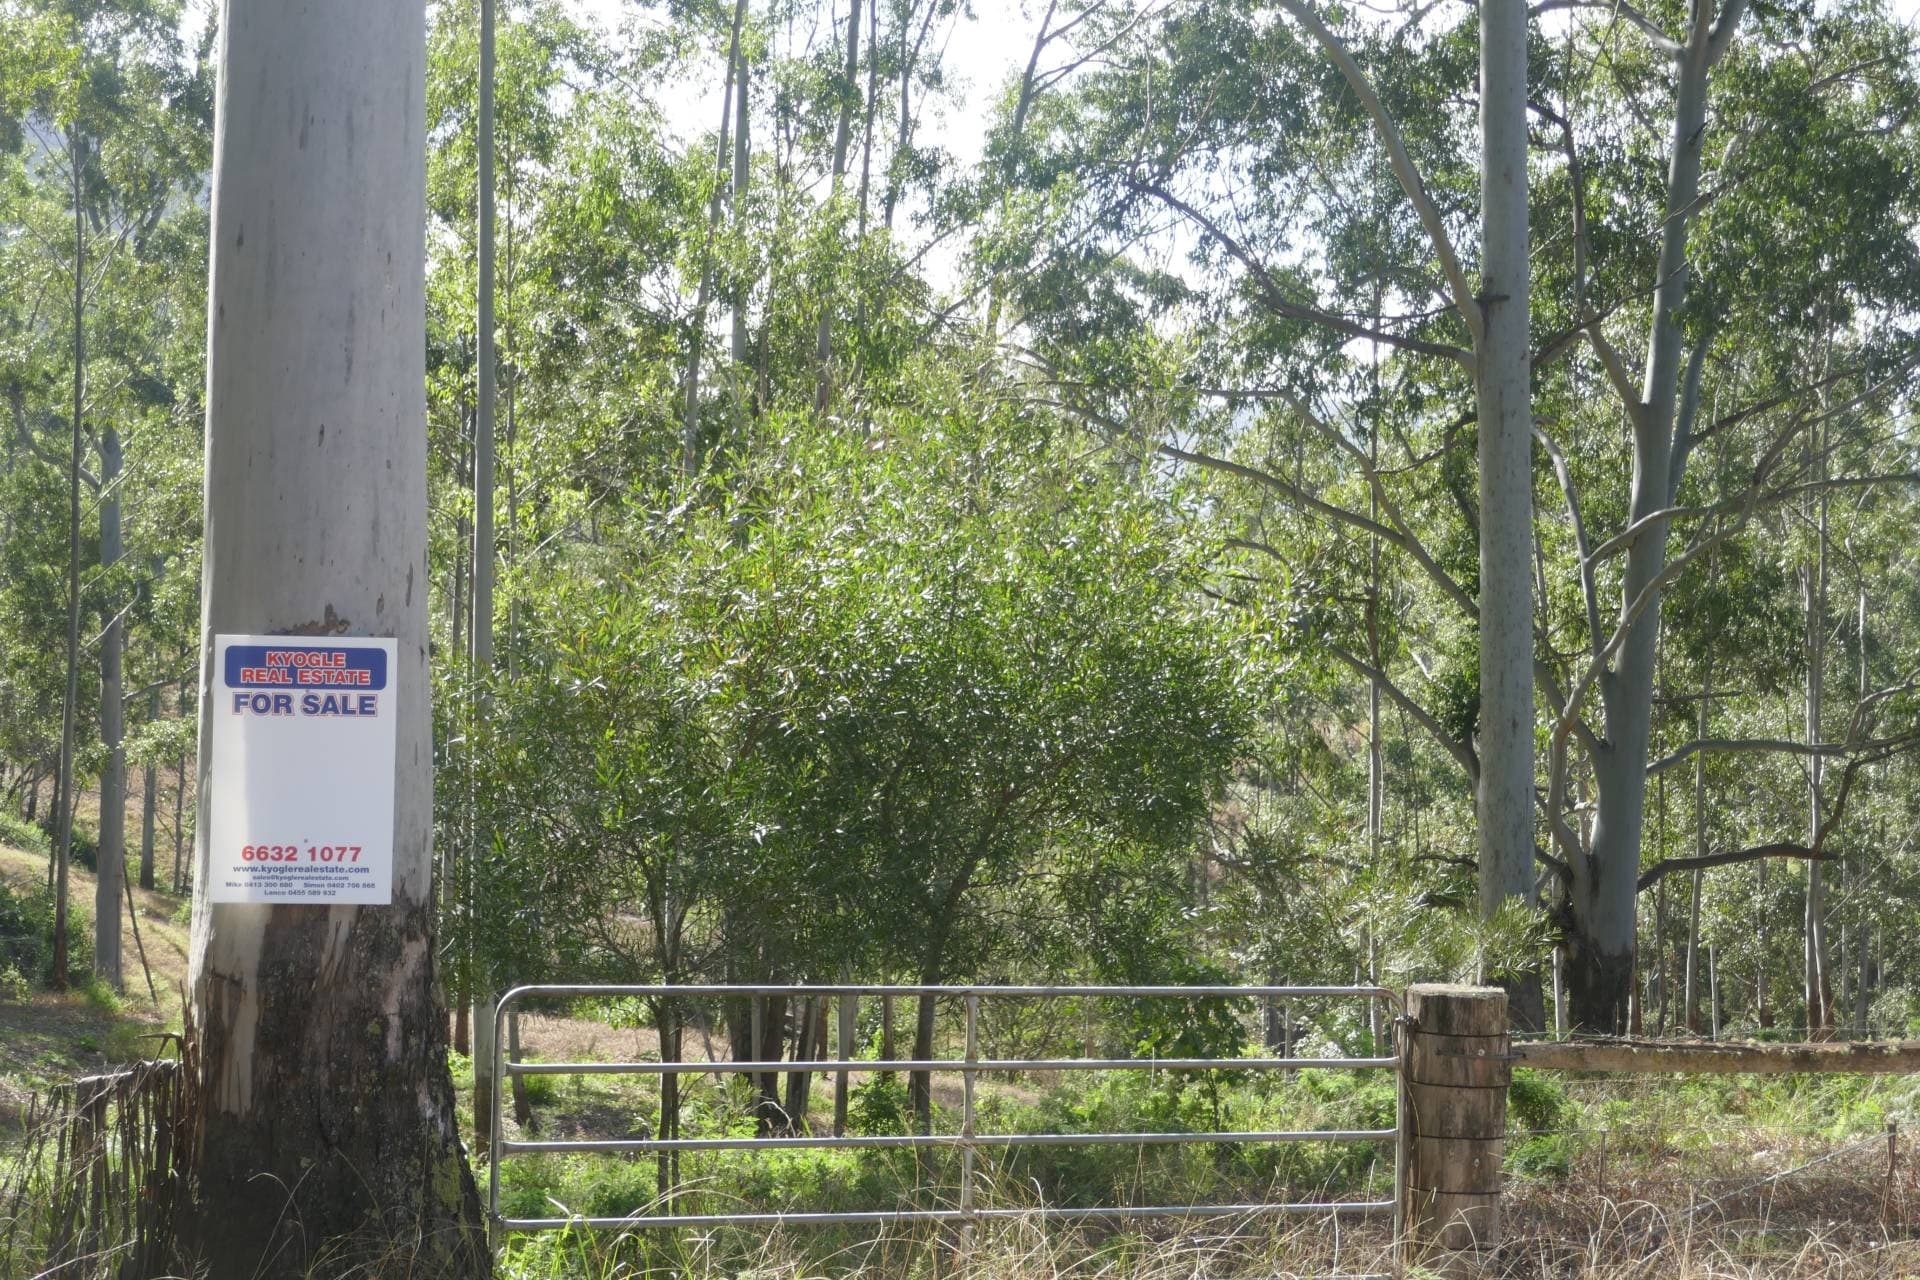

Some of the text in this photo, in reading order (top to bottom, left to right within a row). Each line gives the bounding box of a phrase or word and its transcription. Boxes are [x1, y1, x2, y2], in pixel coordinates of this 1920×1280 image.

[266, 651, 347, 668] KYOGLE
[240, 667, 372, 686] REAL ESTATE
[232, 691, 378, 718] FOR SALE
[241, 845, 362, 863] 6632 1077
[232, 865, 370, 875] www.kyoglerealestate.com
